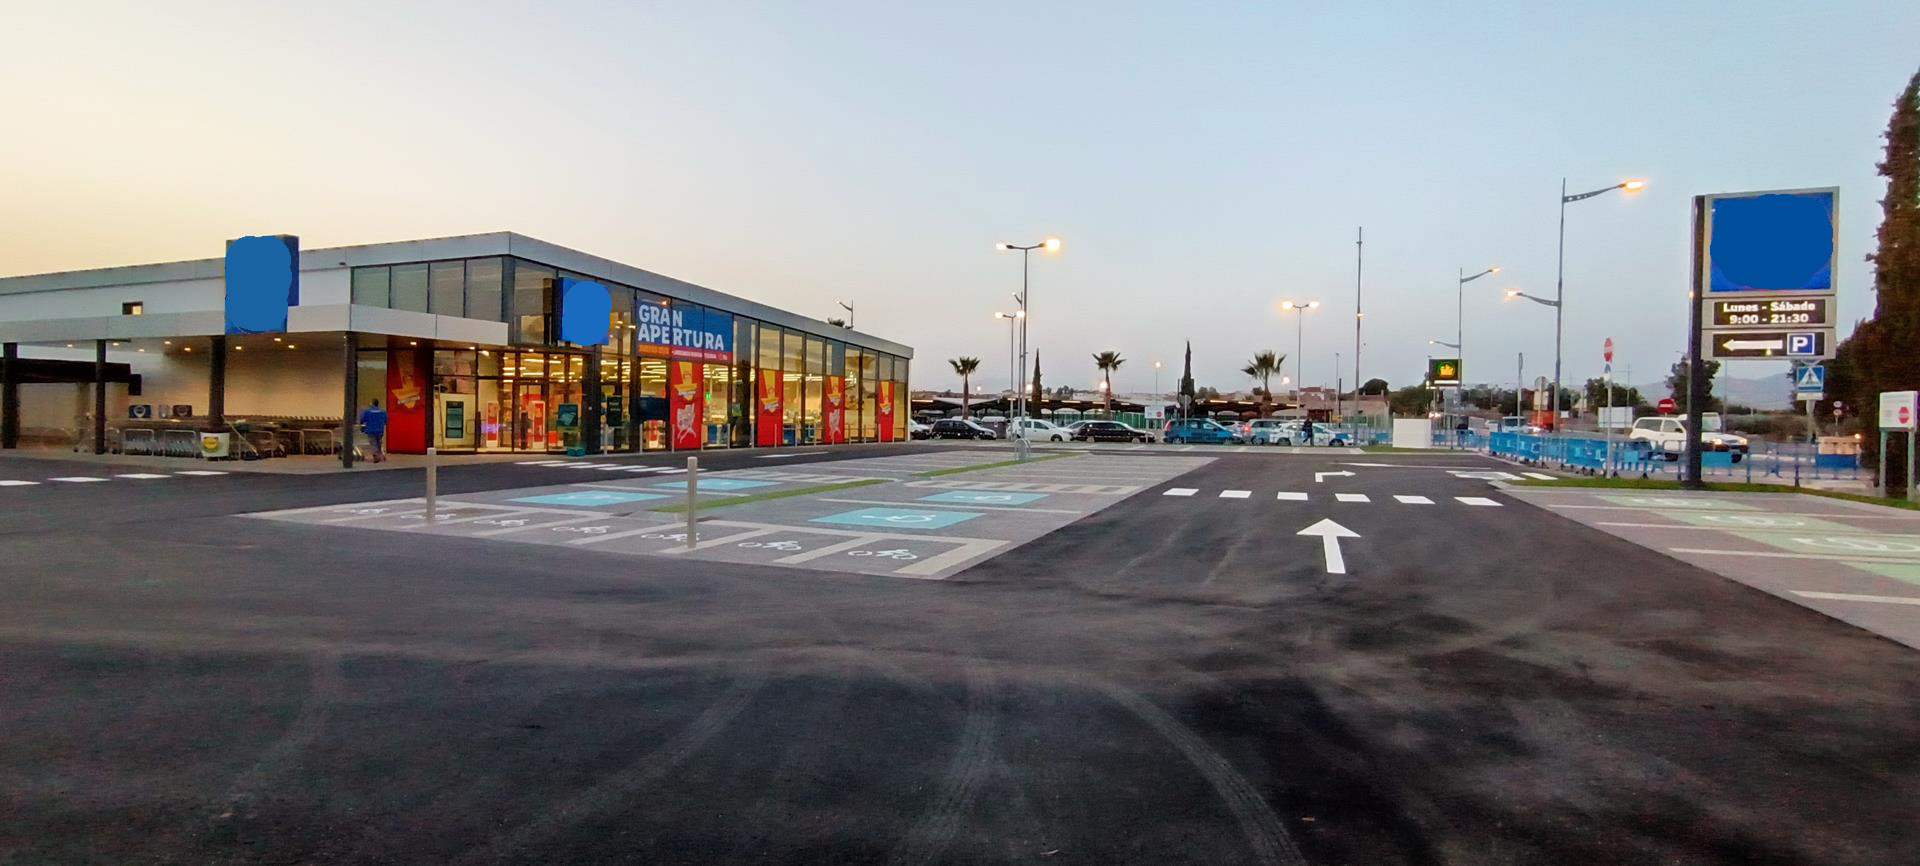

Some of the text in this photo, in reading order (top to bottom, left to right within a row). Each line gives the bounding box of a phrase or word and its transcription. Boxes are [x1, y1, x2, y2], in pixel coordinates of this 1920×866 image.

[1723, 302, 1759, 312] Lunes
[1770, 301, 1816, 312] Sábado
[638, 304, 683, 328] GRAN
[1729, 314, 1759, 324] 9:00
[1770, 313, 1809, 324] 21:30
[638, 323, 725, 351] APERTURA
[1792, 336, 1808, 352] P
